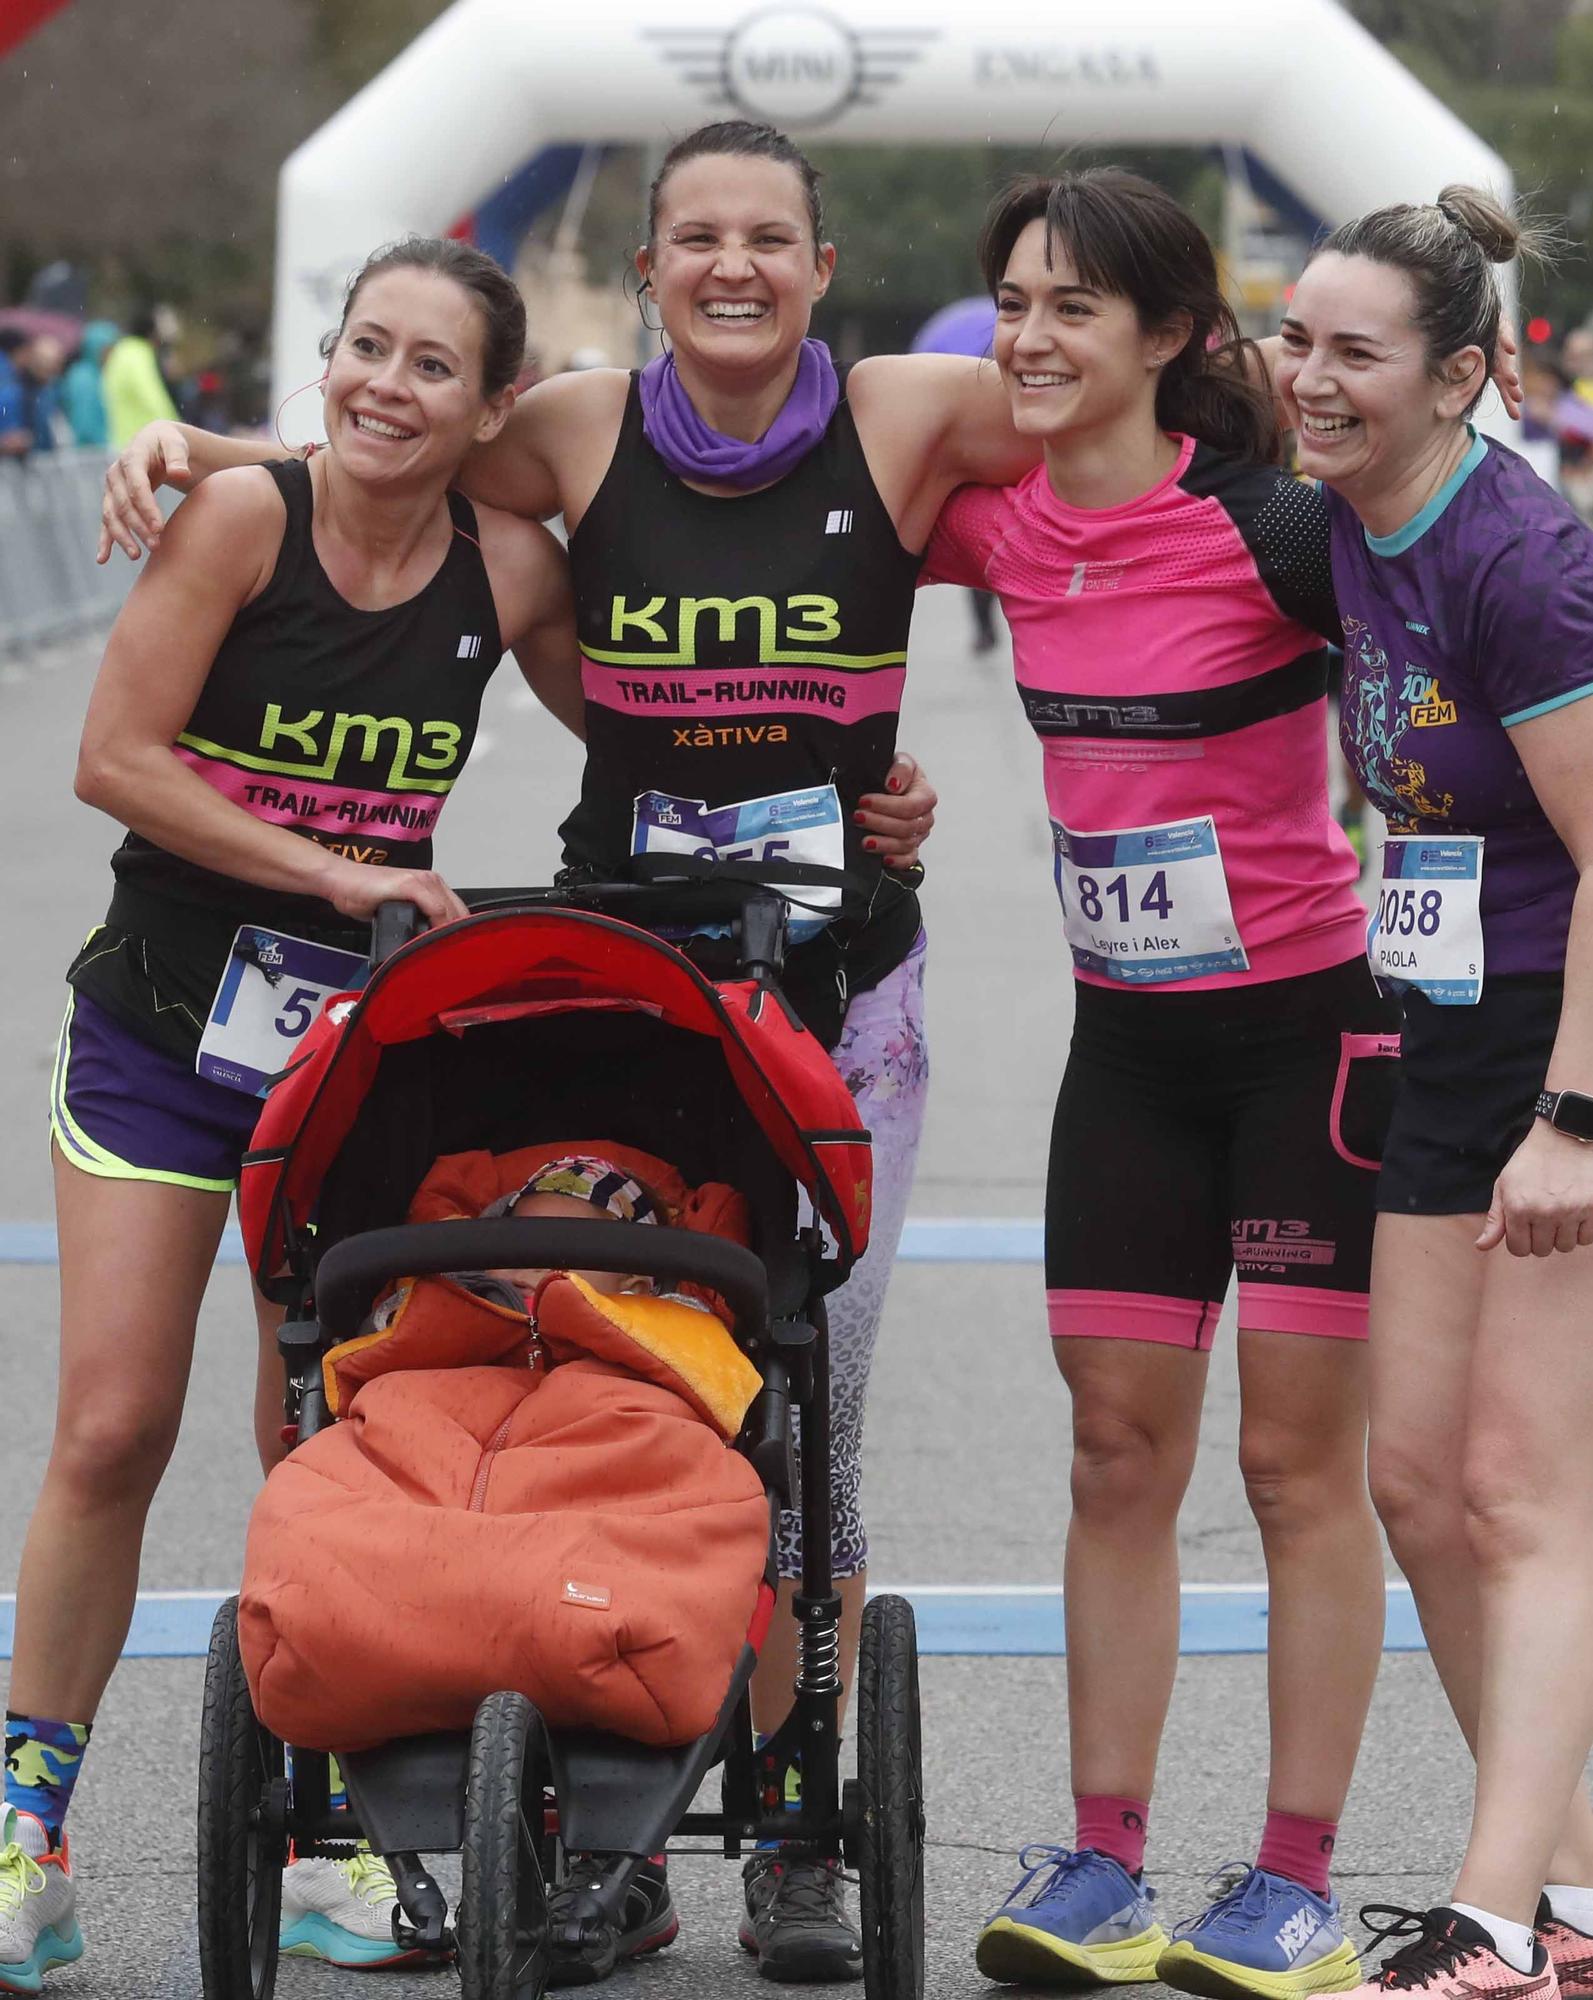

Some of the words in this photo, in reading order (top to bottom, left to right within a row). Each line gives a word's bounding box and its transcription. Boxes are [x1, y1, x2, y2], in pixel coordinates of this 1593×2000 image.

[617, 680, 847, 708] TRAIL-RUNNING
[1414, 702, 1452, 724] FEM
[244, 785, 436, 830] TRAIL-RUNNING
[660, 815, 680, 823] FEM
[1145, 836, 1154, 848] 6
[1167, 829, 1194, 839] Valencia
[1077, 870, 1173, 923] 814
[1091, 935, 1129, 953] Leyre
[1143, 936, 1181, 951] Alex
[259, 952, 282, 963] FEM
[1380, 950, 1417, 968] PAOLA
[1468, 963, 1476, 975] S
